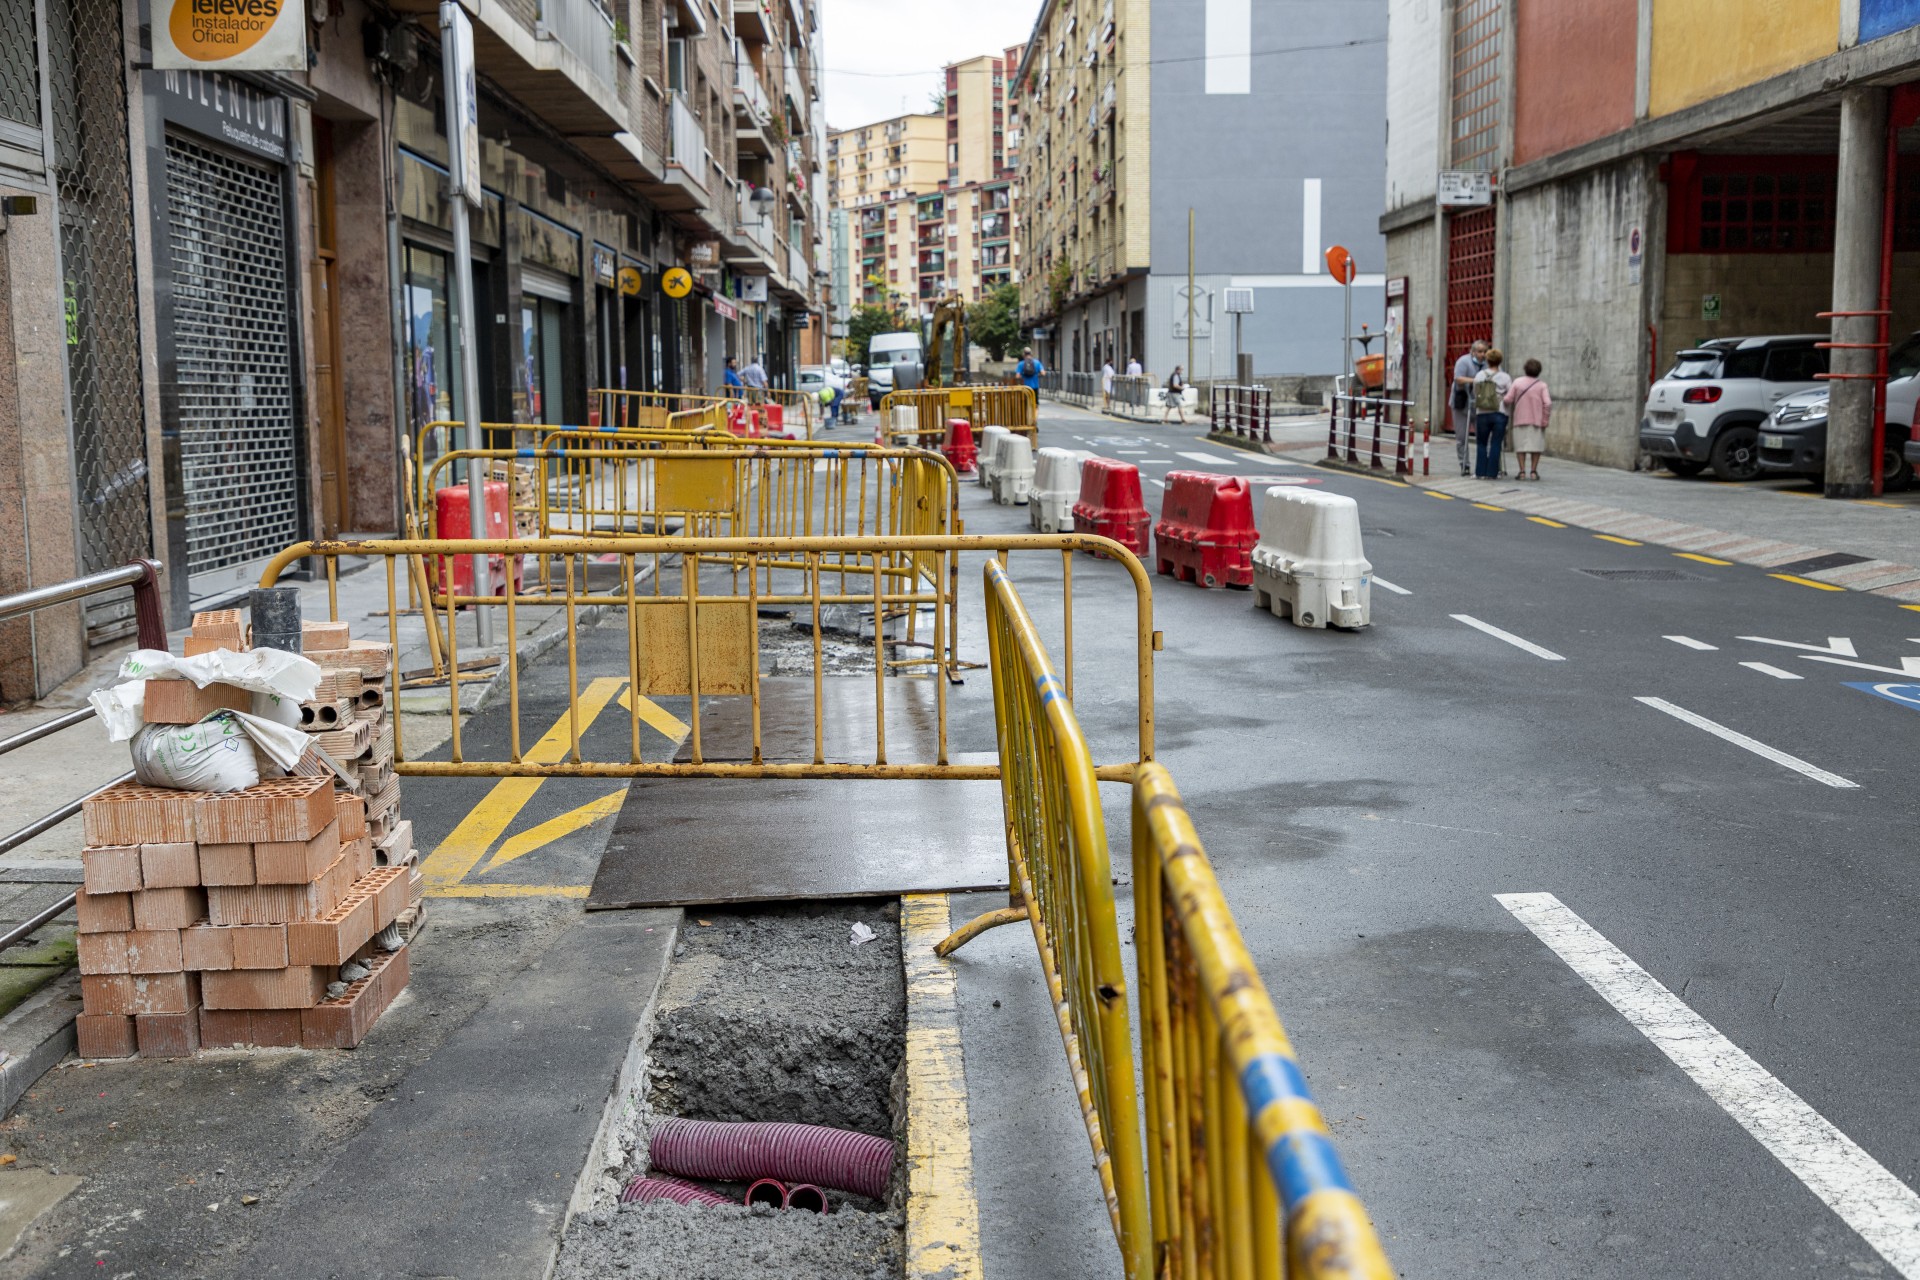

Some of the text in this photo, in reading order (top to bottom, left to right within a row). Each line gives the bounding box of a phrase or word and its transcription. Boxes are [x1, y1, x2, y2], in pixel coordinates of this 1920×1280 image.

[192, 15, 266, 31] Instalador
[192, 29, 239, 44] Oficial
[165, 69, 284, 138] MILENIUM
